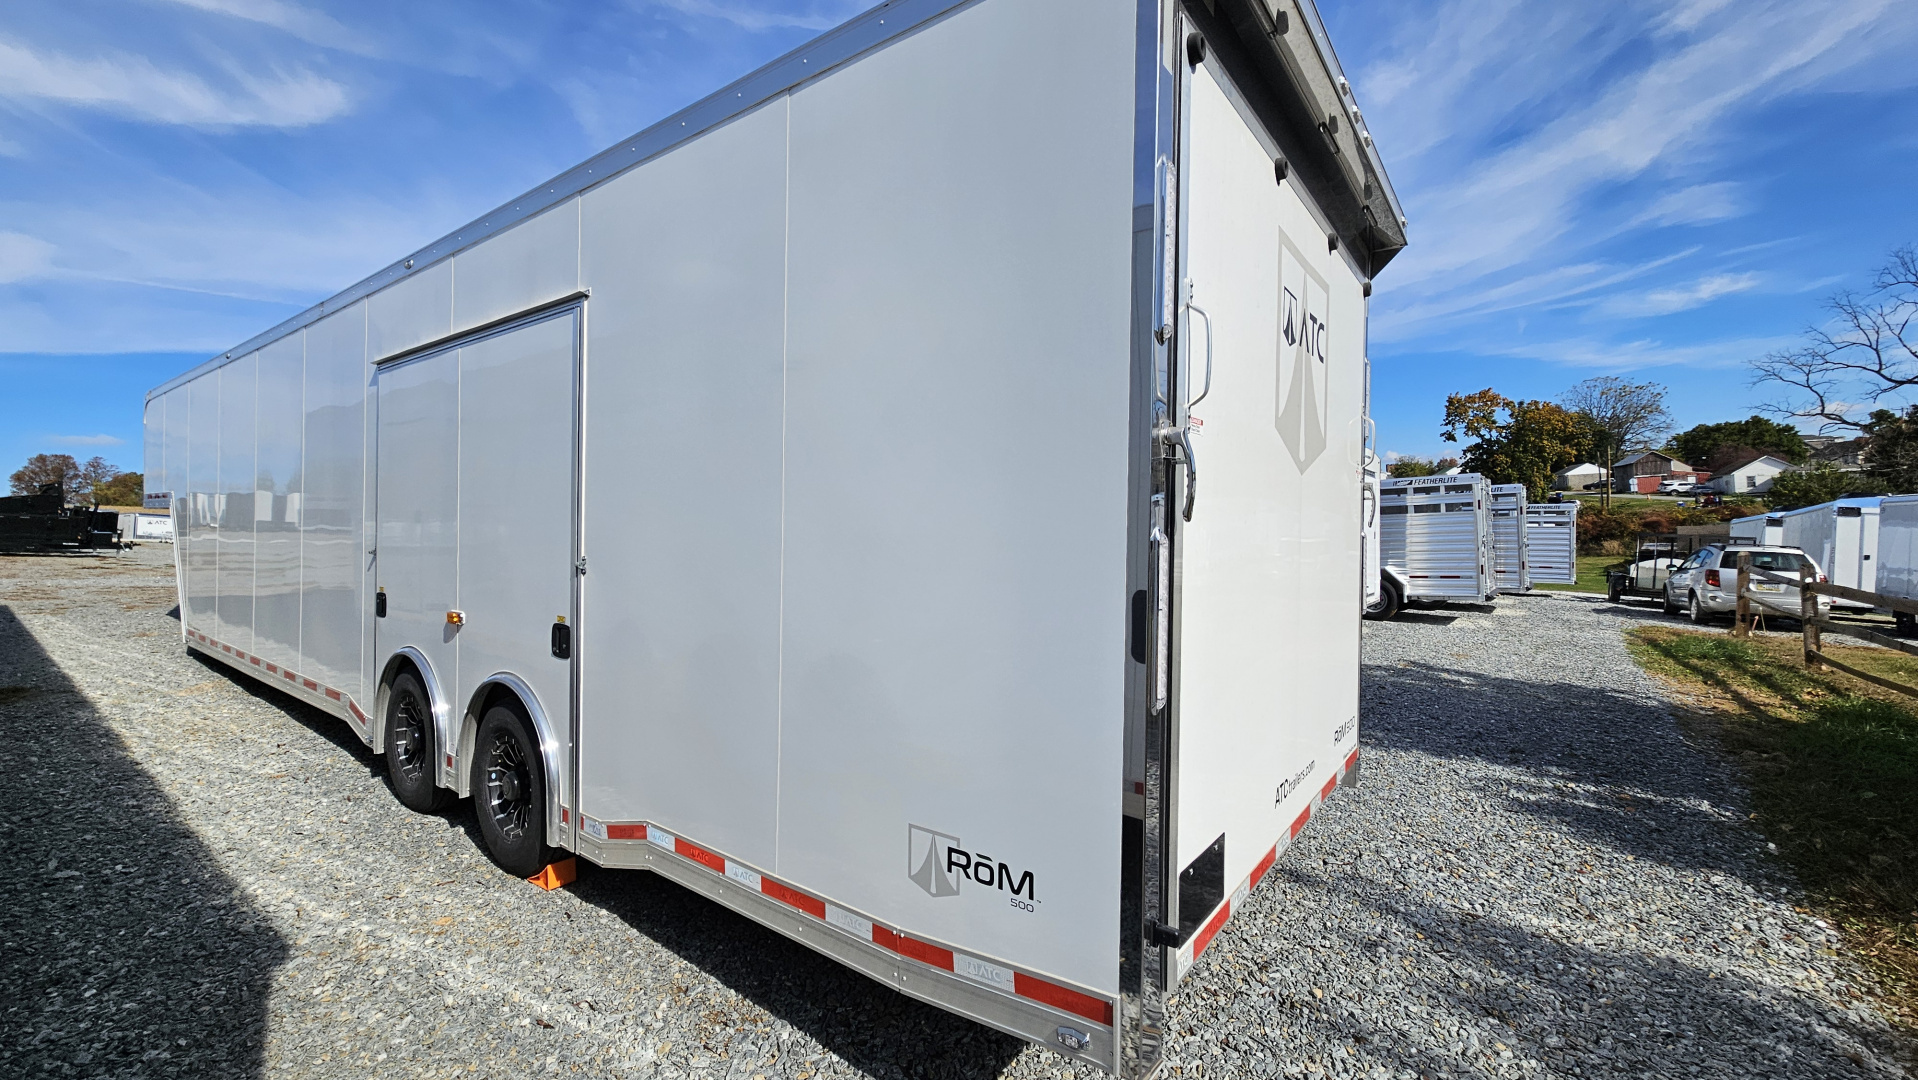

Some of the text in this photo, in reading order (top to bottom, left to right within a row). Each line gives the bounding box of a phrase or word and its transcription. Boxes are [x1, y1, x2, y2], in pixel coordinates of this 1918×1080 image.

[1299, 308, 1325, 364] ATC
[1413, 476, 1458, 486] FEATHERLITE
[1274, 759, 1316, 809] ATCtrailers.com
[739, 871, 753, 884] ATC
[947, 845, 1034, 901] RōM
[1010, 897, 1034, 913] 500
[979, 965, 1001, 982] ATC
